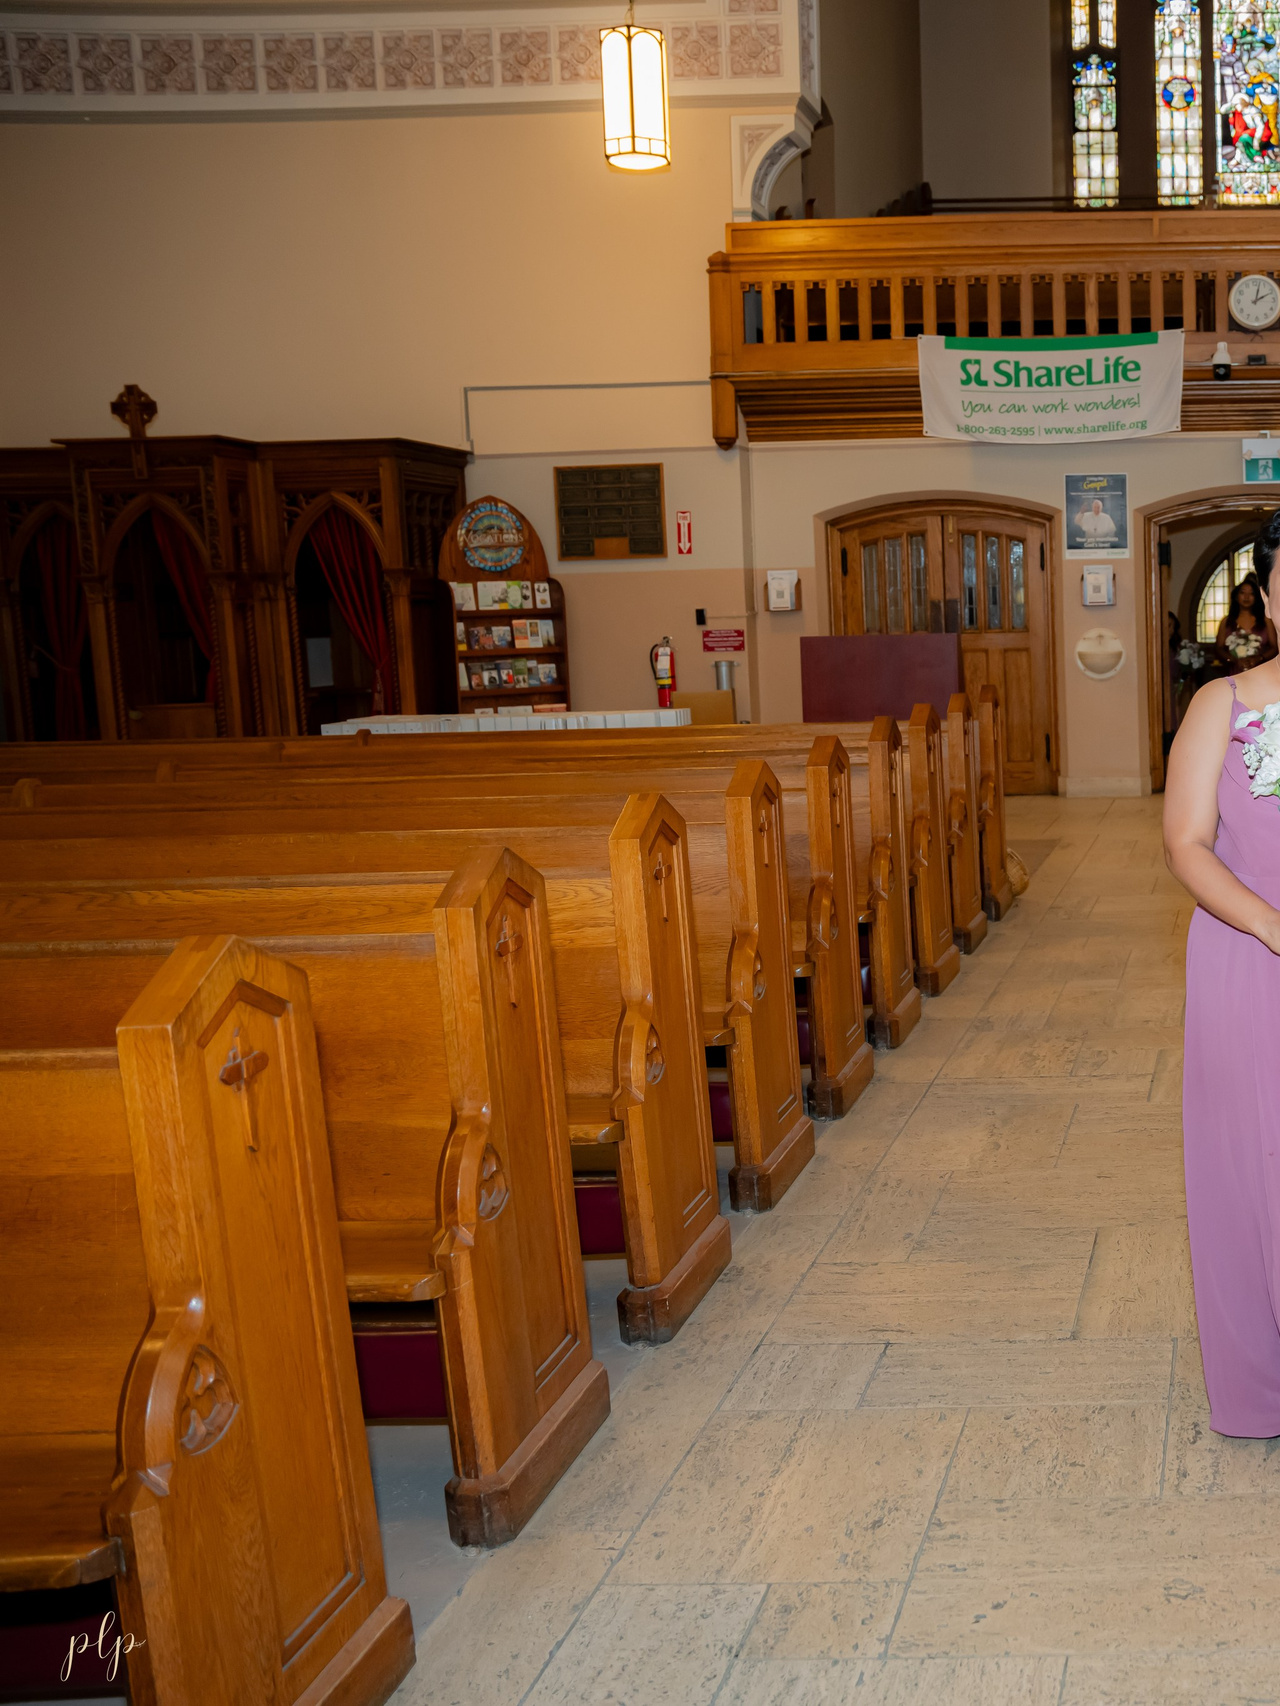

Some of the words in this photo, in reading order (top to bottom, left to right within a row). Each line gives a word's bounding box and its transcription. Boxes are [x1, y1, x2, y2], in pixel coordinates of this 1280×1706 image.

[993, 356, 1141, 388] ShareLife
[961, 399, 992, 418] You
[998, 402, 1028, 414] can
[1032, 399, 1070, 414] work
[1074, 393, 1141, 413] wonders!
[956, 424, 1035, 436] 1-800-263-2595
[1044, 420, 1148, 436] www.sharelife.org
[1084, 478, 1108, 491] Gospel
